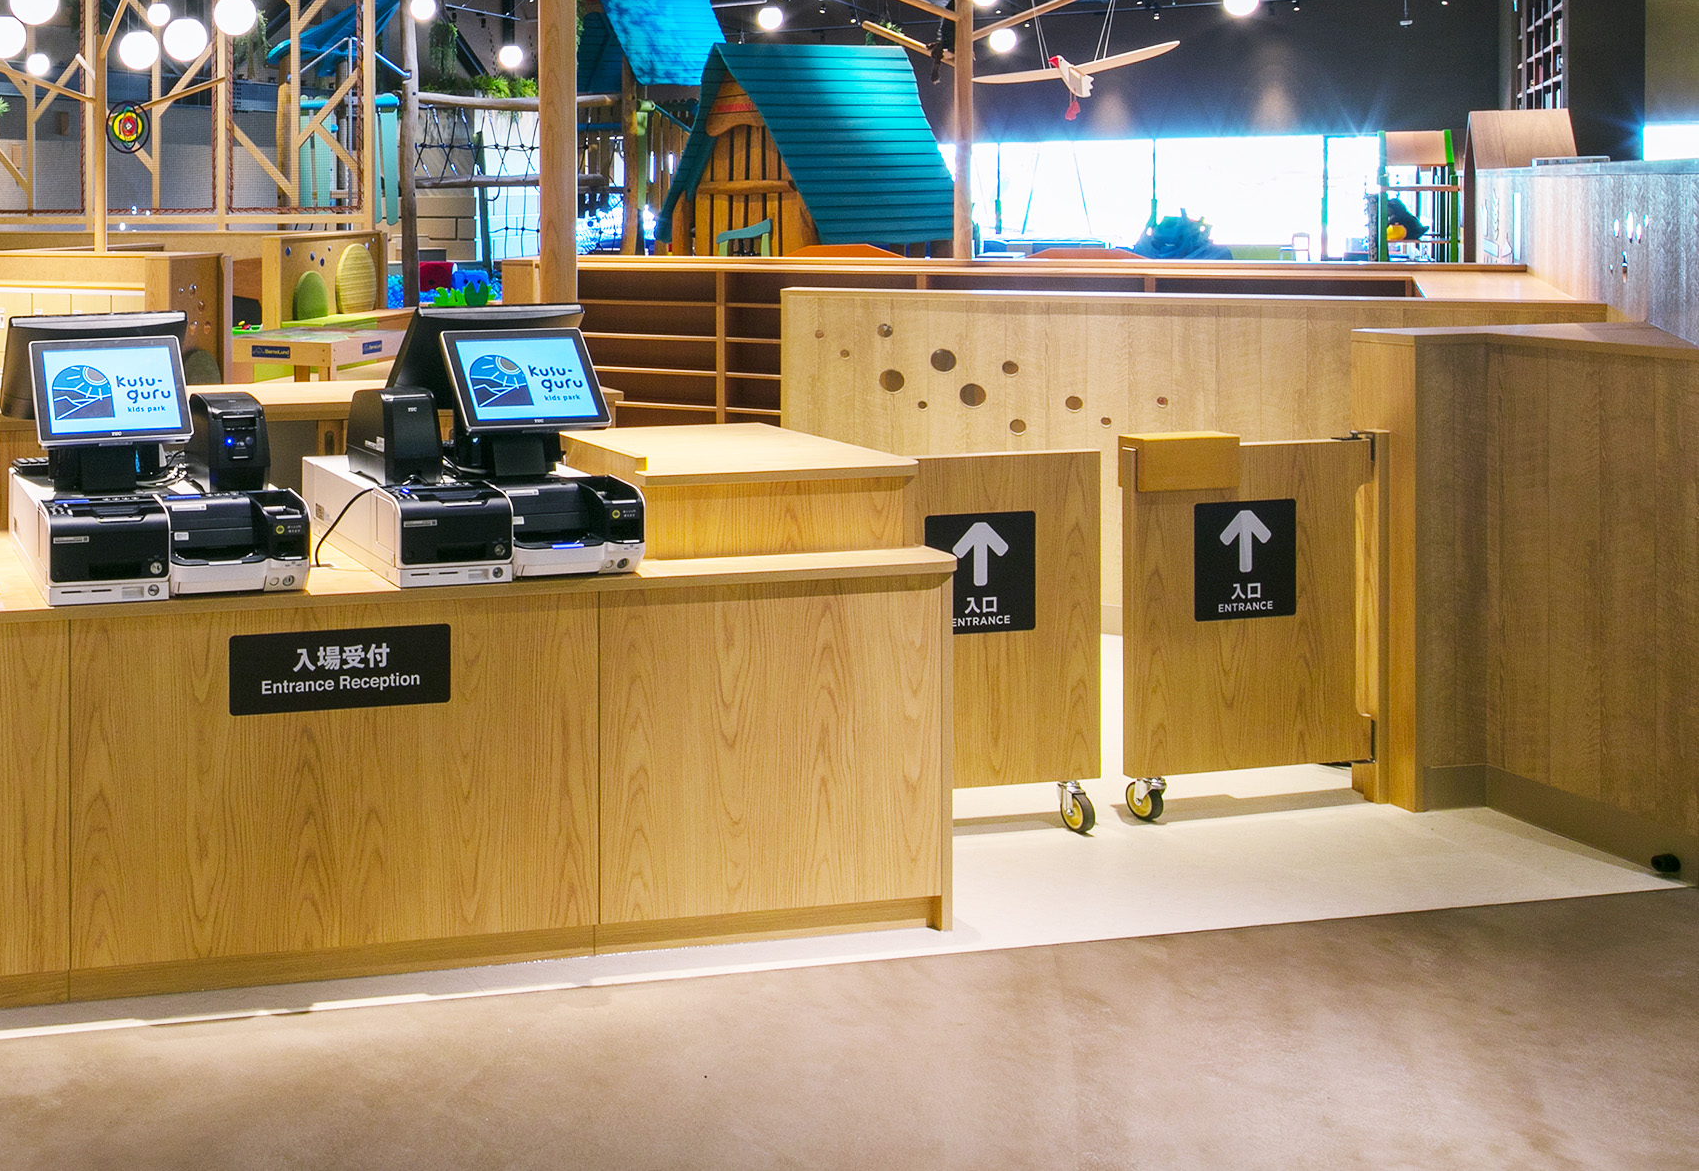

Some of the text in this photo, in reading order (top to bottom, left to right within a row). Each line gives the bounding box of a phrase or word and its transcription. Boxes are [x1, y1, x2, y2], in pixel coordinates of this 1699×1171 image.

[527, 364, 573, 377] kusu-
[115, 375, 163, 388] kusu-
[541, 378, 583, 393] guru
[126, 389, 171, 404] guru
[147, 405, 166, 413] park
[1231, 582, 1262, 600] 入口
[964, 596, 998, 615] 入口
[1217, 600, 1274, 613] ENTRANCE
[292, 642, 391, 673] 入場受付
[261, 672, 421, 695] Entrance Reception
